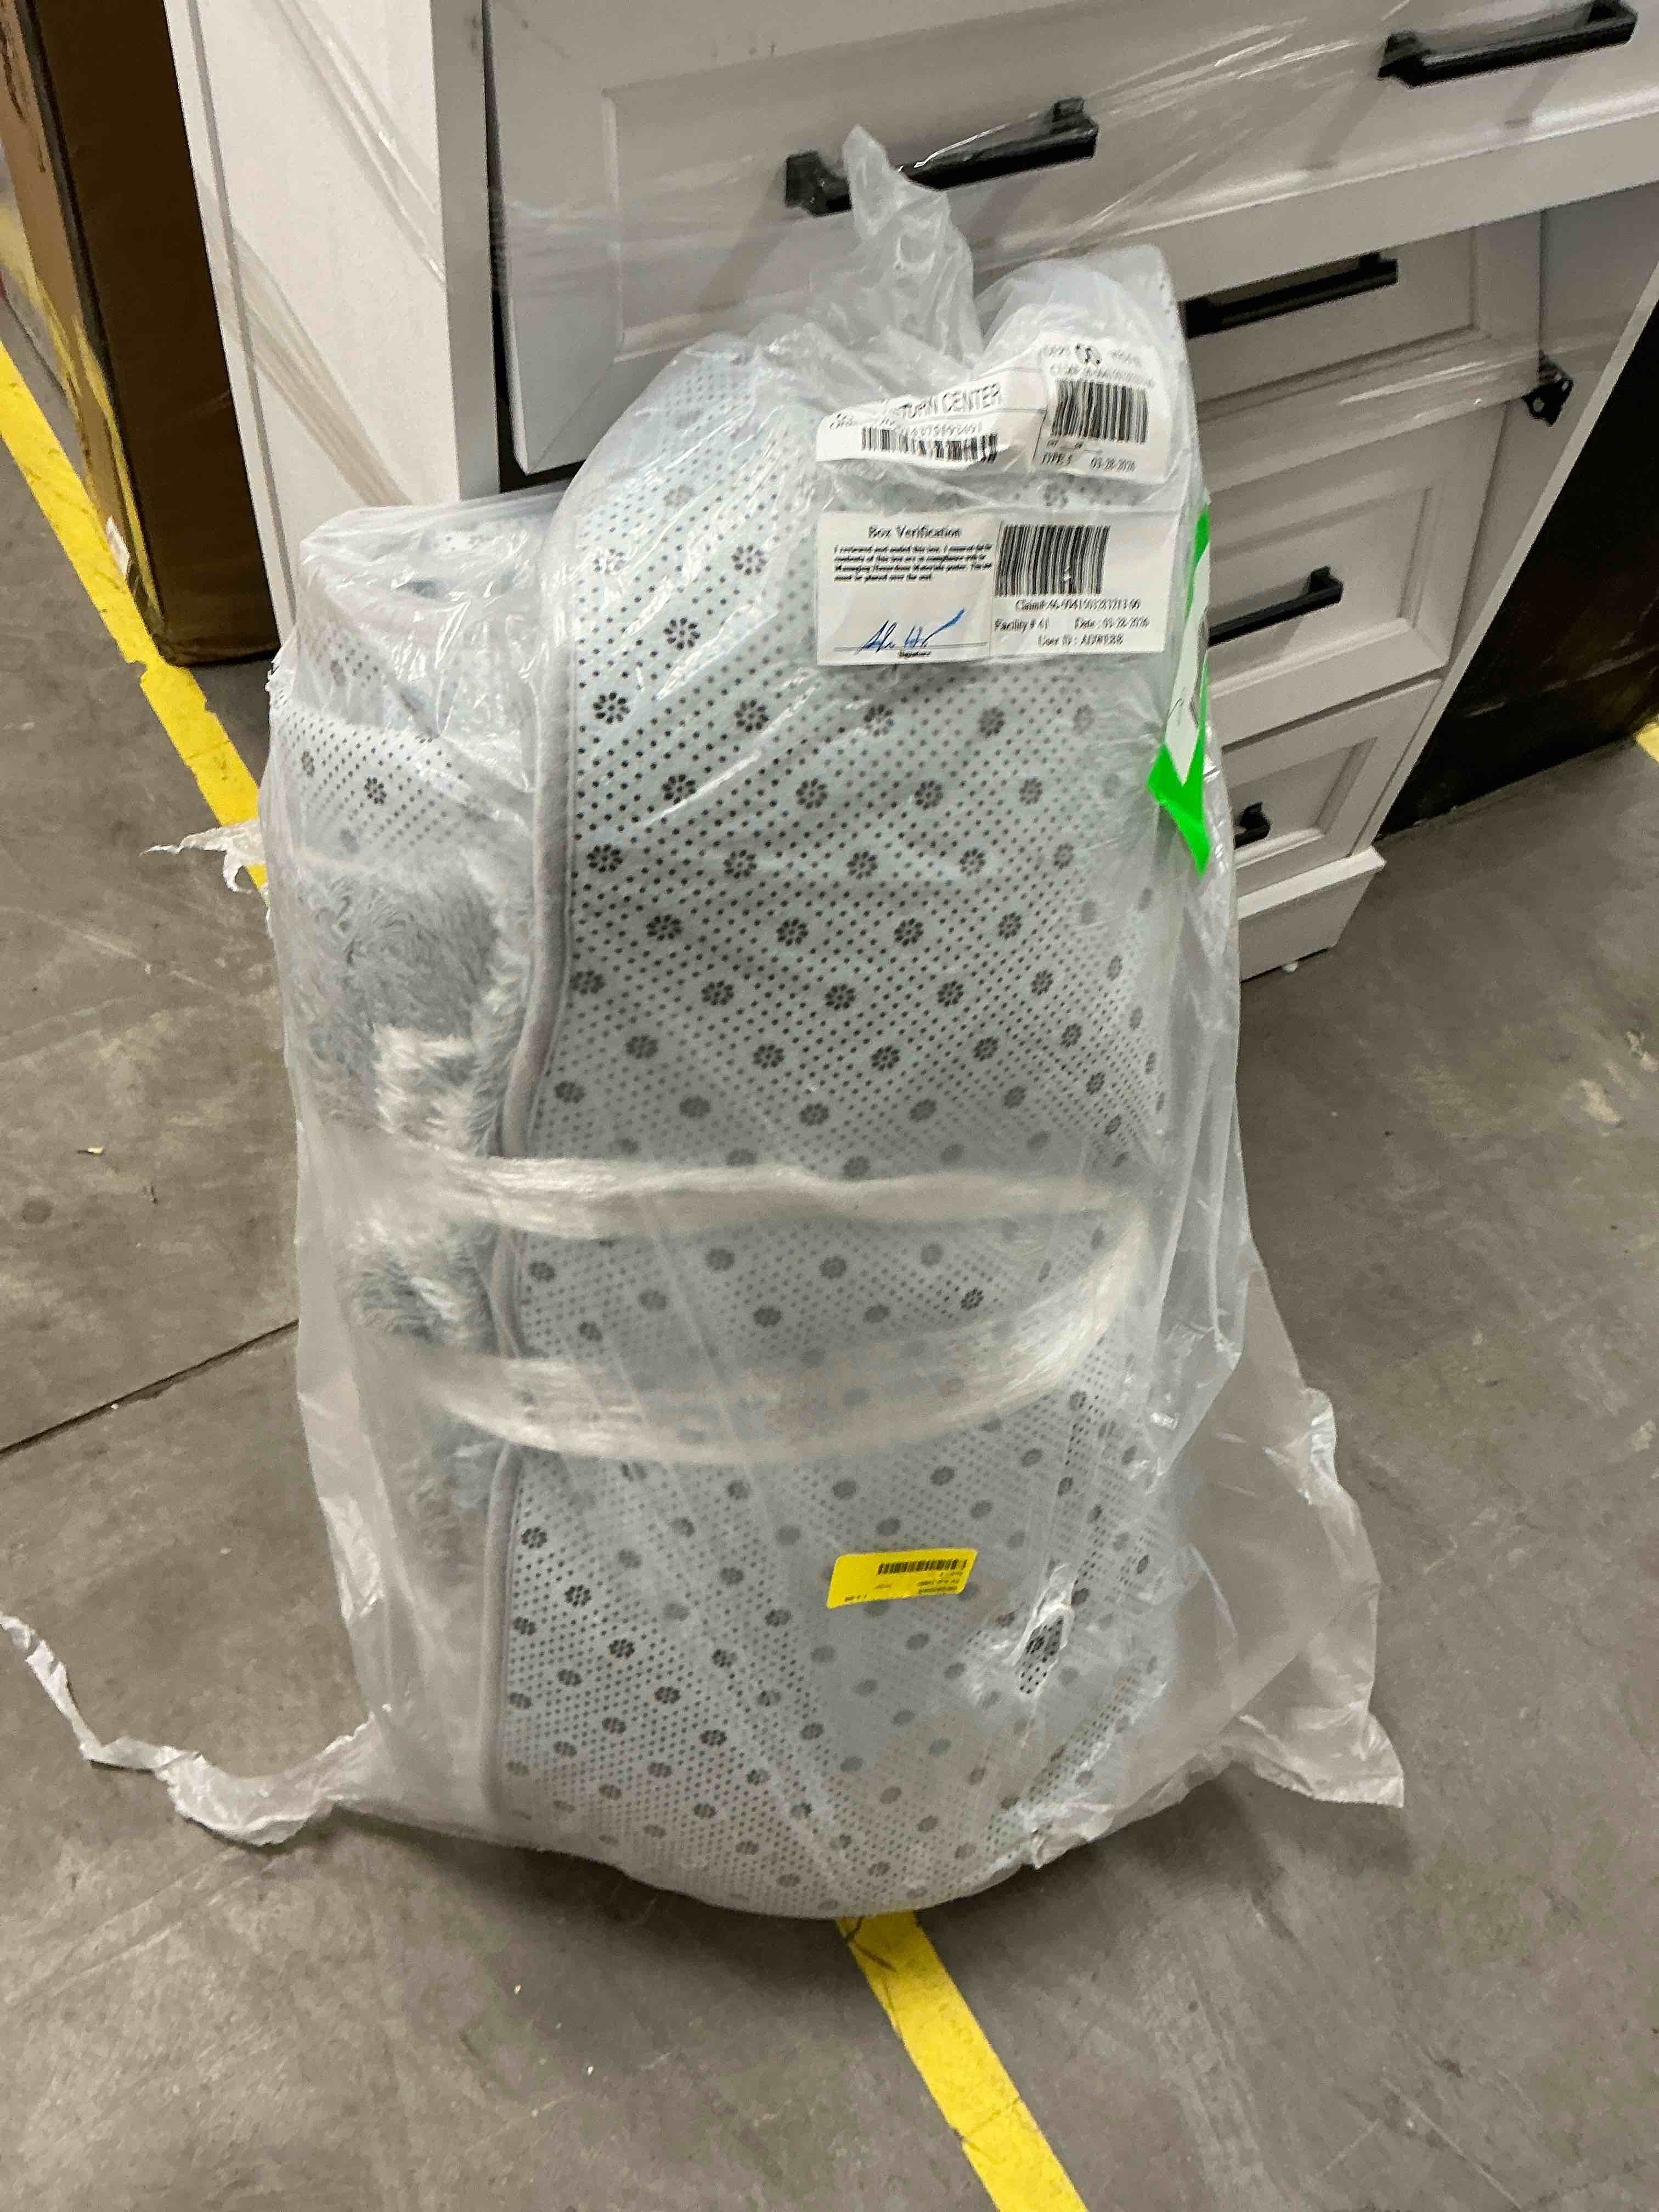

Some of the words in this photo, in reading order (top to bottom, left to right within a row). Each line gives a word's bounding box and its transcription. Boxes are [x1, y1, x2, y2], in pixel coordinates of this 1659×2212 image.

[942, 381, 1001, 413] CENTER
[869, 526, 891, 538] Box
[896, 524, 962, 538] Verification
[994, 619, 1029, 633] Facility
